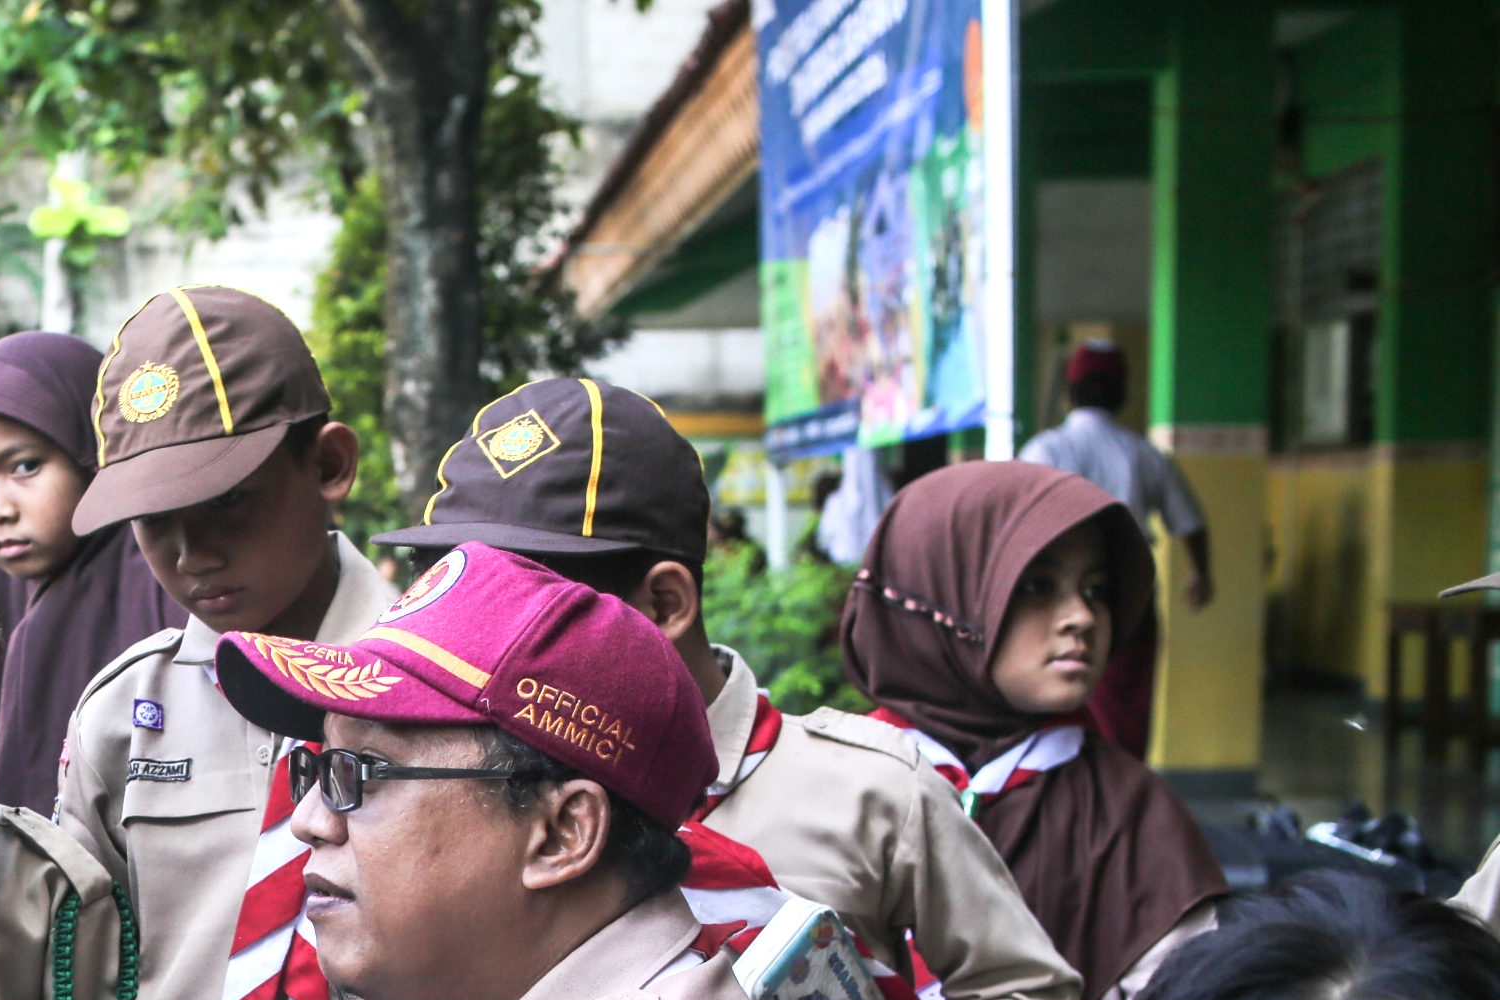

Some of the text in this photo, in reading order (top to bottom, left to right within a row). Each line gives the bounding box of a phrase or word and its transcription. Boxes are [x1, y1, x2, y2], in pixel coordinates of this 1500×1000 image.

[304, 644, 354, 667] CERIA
[513, 703, 623, 766] AMMICI
[516, 678, 636, 751] OFFICIAL
